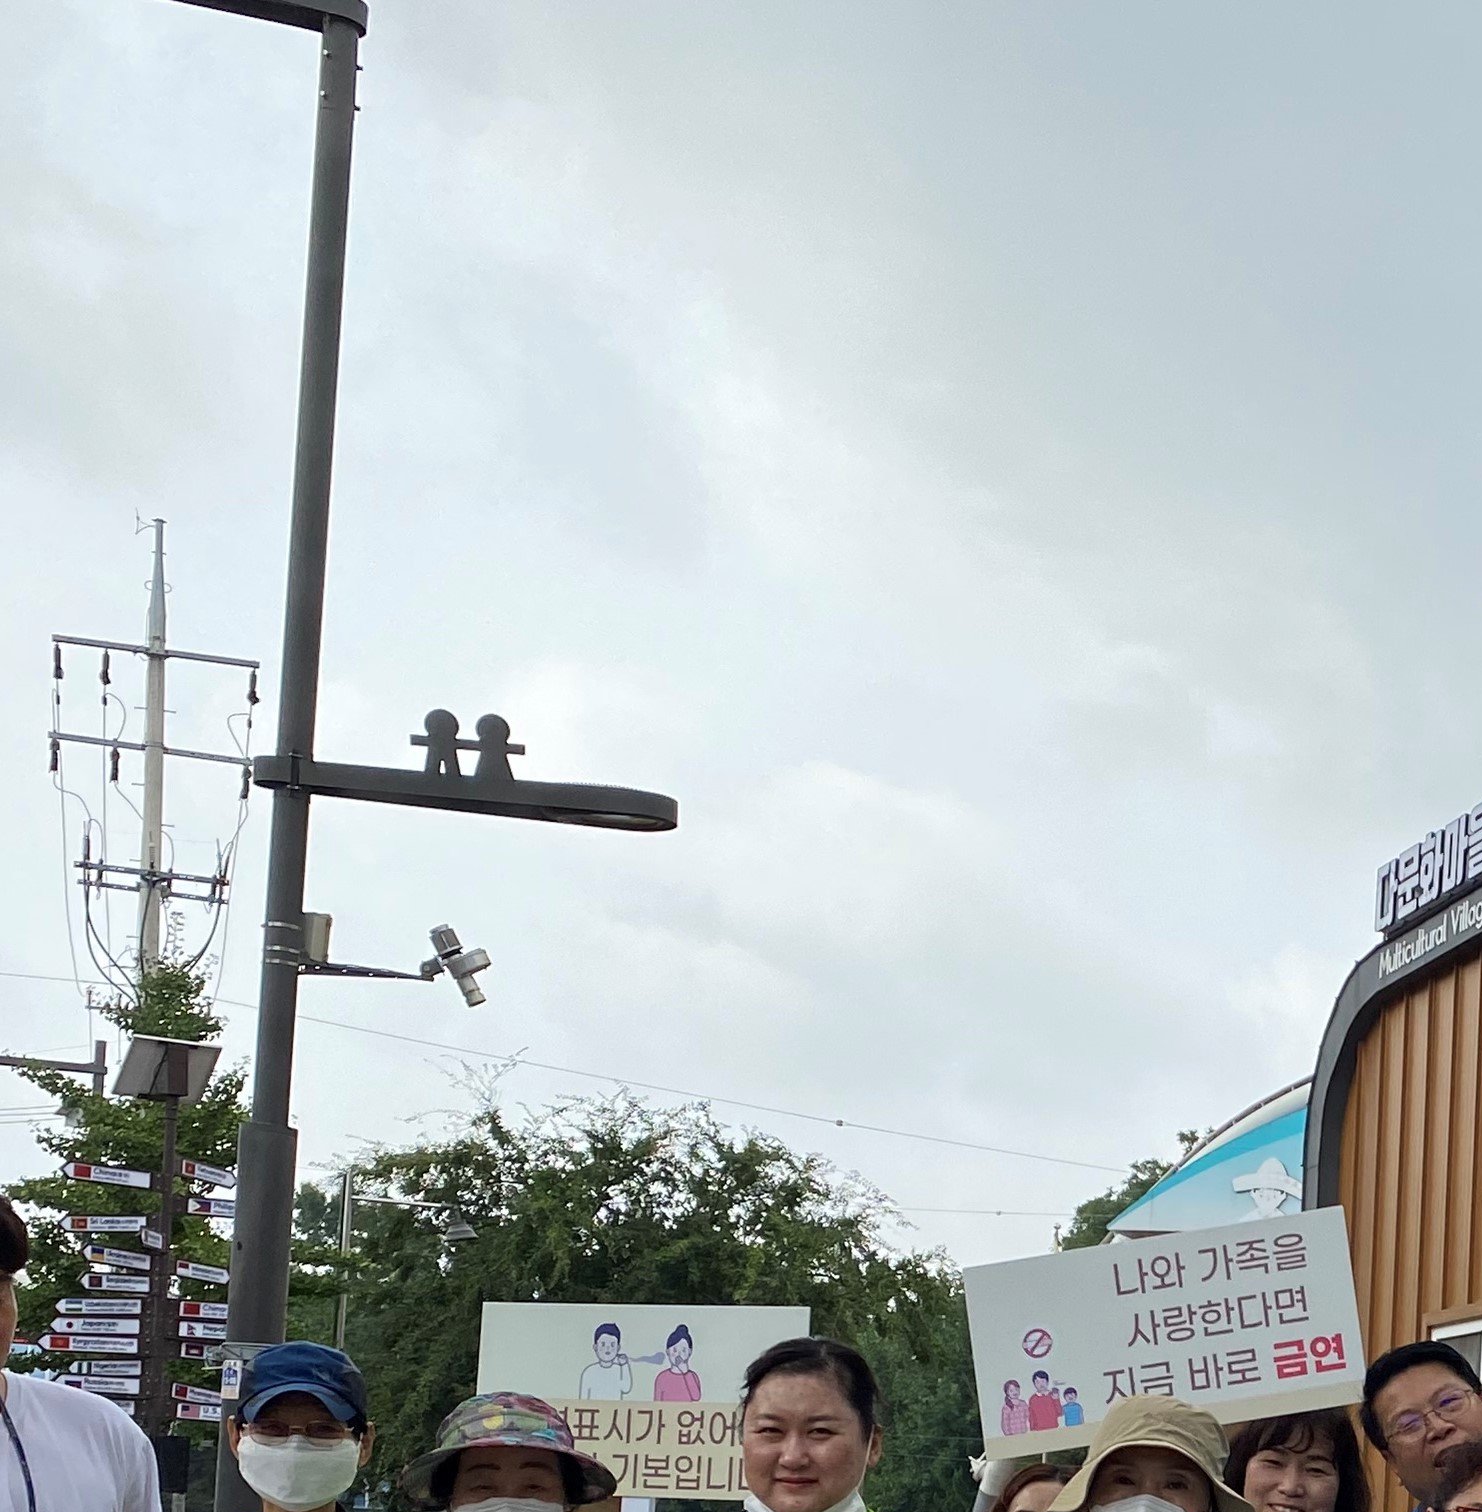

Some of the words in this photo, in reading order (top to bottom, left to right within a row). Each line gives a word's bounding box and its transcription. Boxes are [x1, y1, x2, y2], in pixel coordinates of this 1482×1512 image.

[1378, 919, 1447, 978] Multicultural
[1113, 1253, 1185, 1296] 나와
[1198, 1233, 1308, 1284] 가족을
[1128, 1286, 1309, 1347] 사랑한다면
[1103, 1361, 1175, 1404] 지금
[1189, 1348, 1262, 1392] 바로
[1272, 1333, 1347, 1380] 금연
[564, 1407, 665, 1444] 표시가
